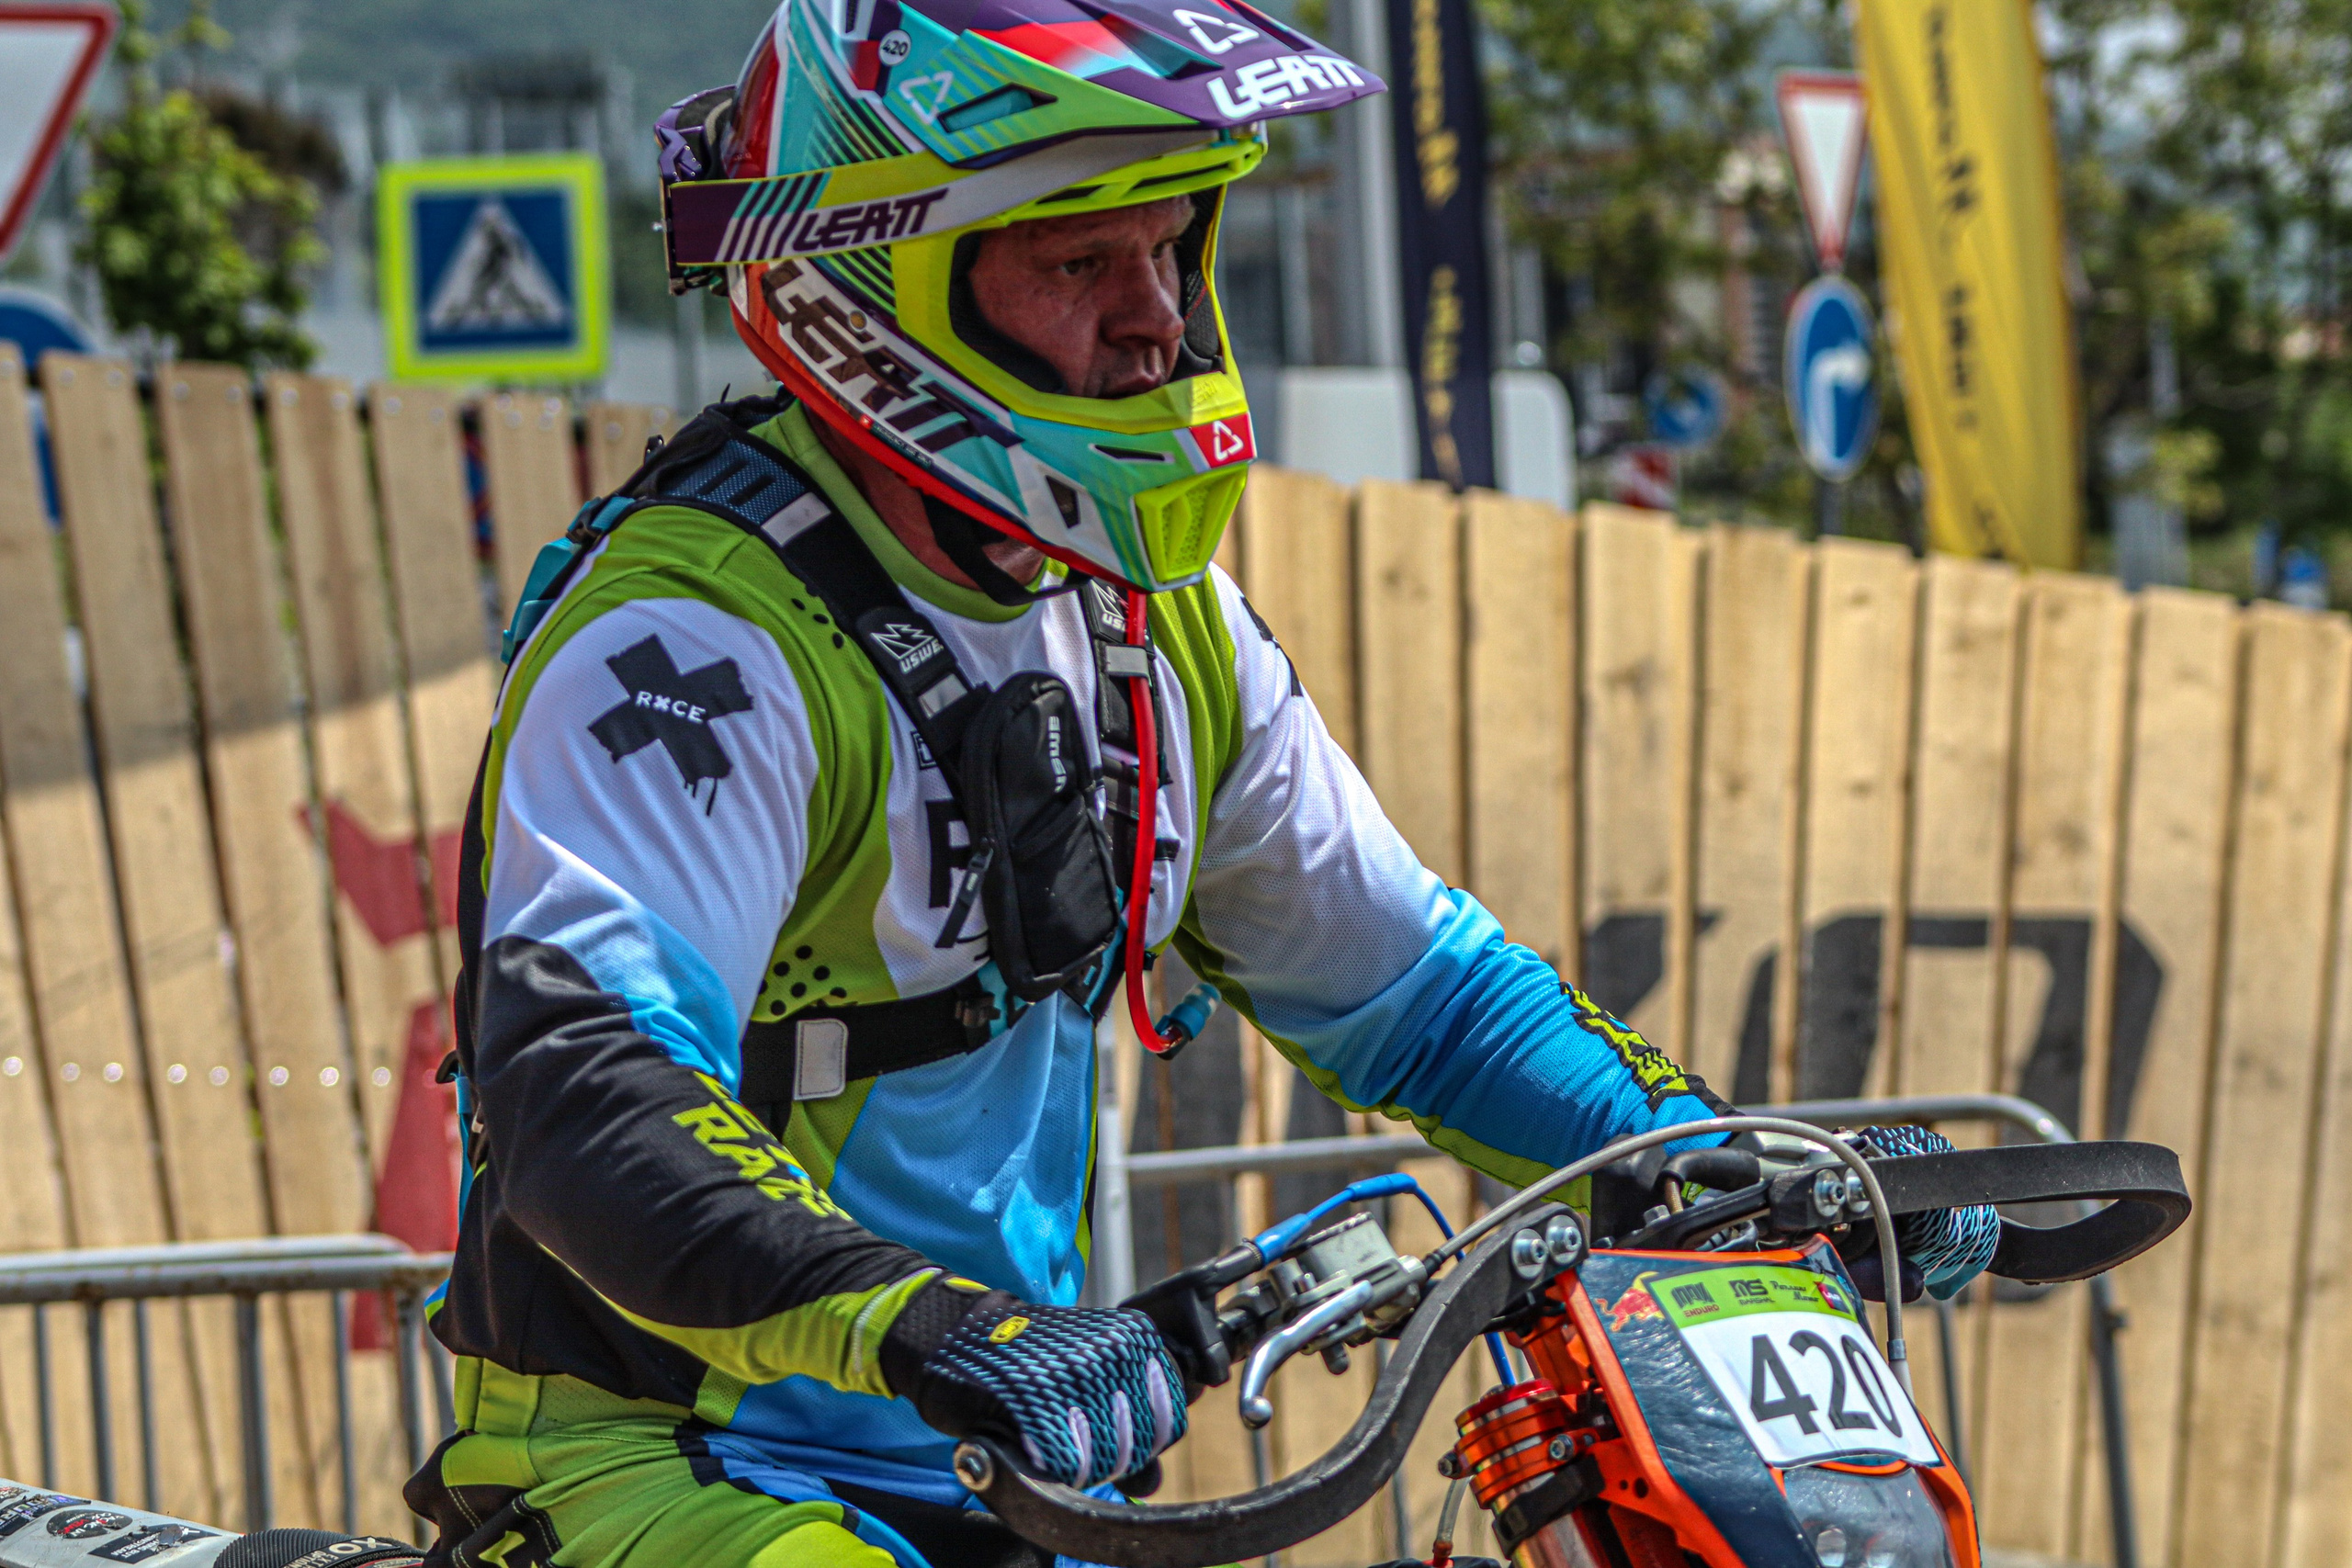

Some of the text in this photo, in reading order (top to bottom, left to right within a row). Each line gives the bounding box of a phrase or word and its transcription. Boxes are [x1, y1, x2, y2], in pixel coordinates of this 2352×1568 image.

[882, 39, 909, 57] 420
[1206, 54, 1365, 119] LEATT
[793, 187, 949, 253] LEATT
[762, 258, 1022, 455] LEATT
[1102, 613, 1126, 633] US
[900, 638, 944, 674] USWE
[1048, 716, 1068, 794] USWE
[1683, 1303, 1720, 1319] ENDURO
[1750, 1329, 1903, 1438] 420
